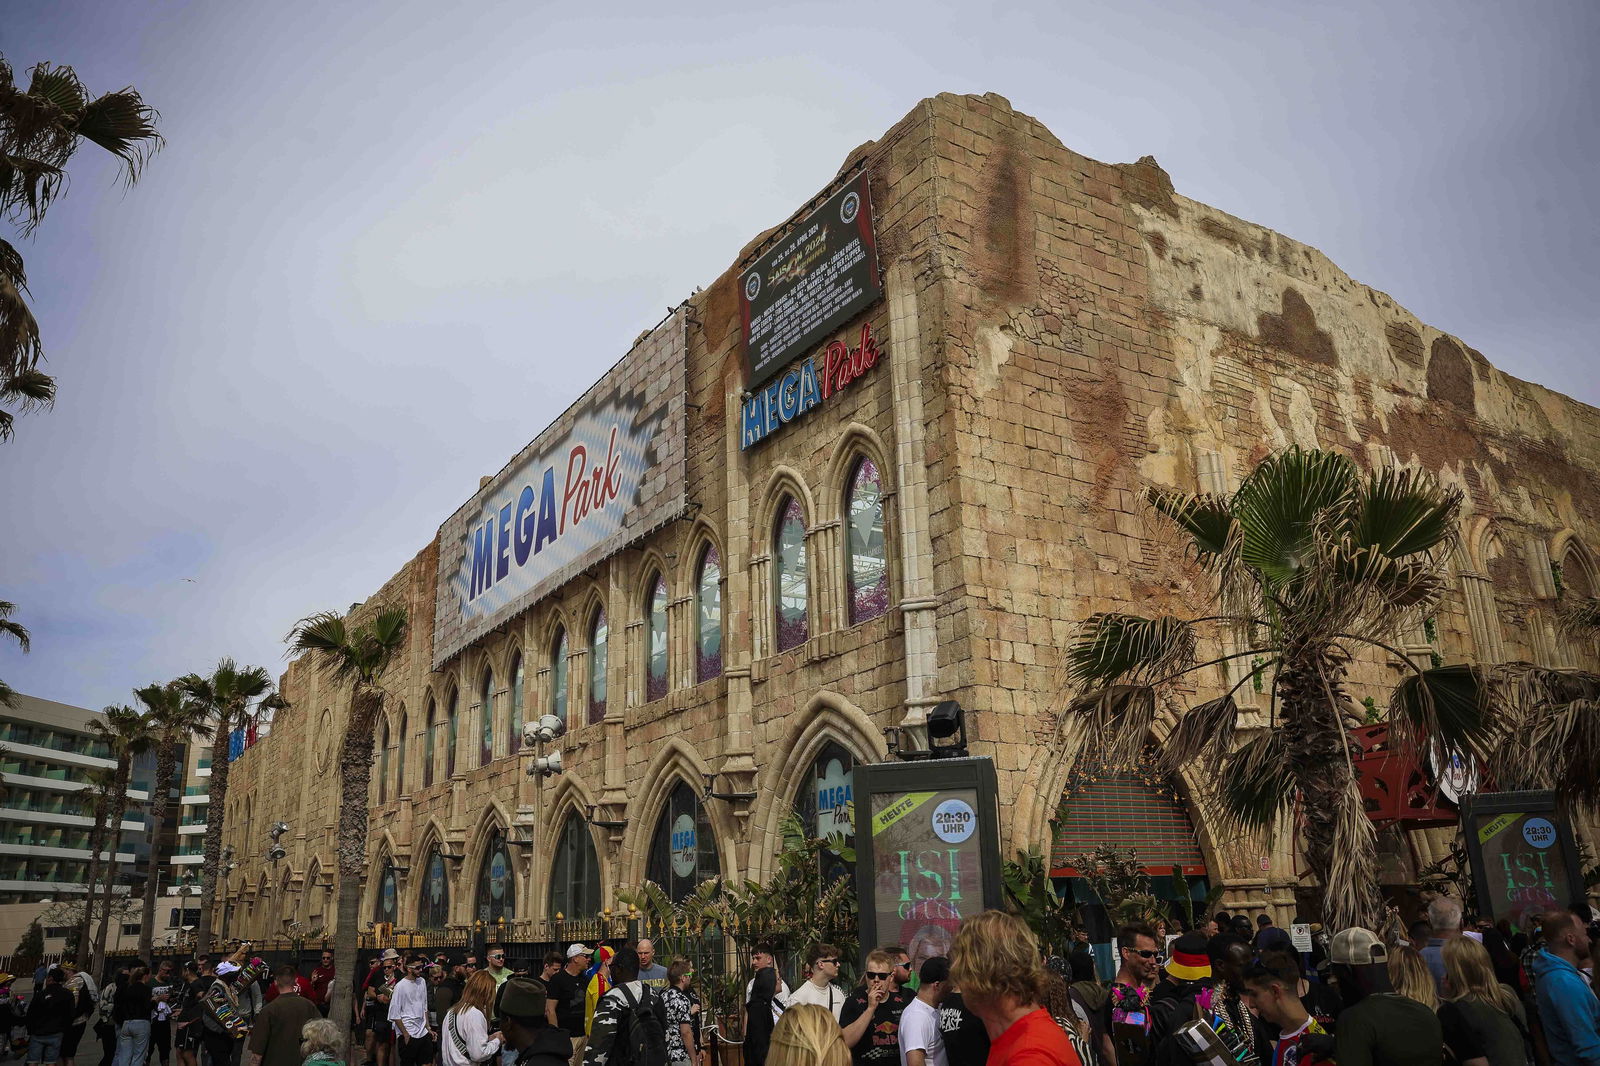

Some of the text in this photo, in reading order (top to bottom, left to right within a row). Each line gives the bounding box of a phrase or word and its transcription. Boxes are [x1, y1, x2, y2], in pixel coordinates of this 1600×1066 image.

[740, 322, 879, 451] MEGA Park
[469, 427, 622, 602] MEGA Park
[818, 784, 852, 811] MEGA
[833, 803, 851, 824] Par
[880, 798, 914, 825] HEUTE
[672, 831, 696, 849] MEGA
[942, 823, 965, 834] UHR
[1483, 817, 1507, 837] HEUTE
[1531, 834, 1549, 842] UHR
[896, 848, 964, 902] ISI
[1500, 851, 1554, 889] ISI
